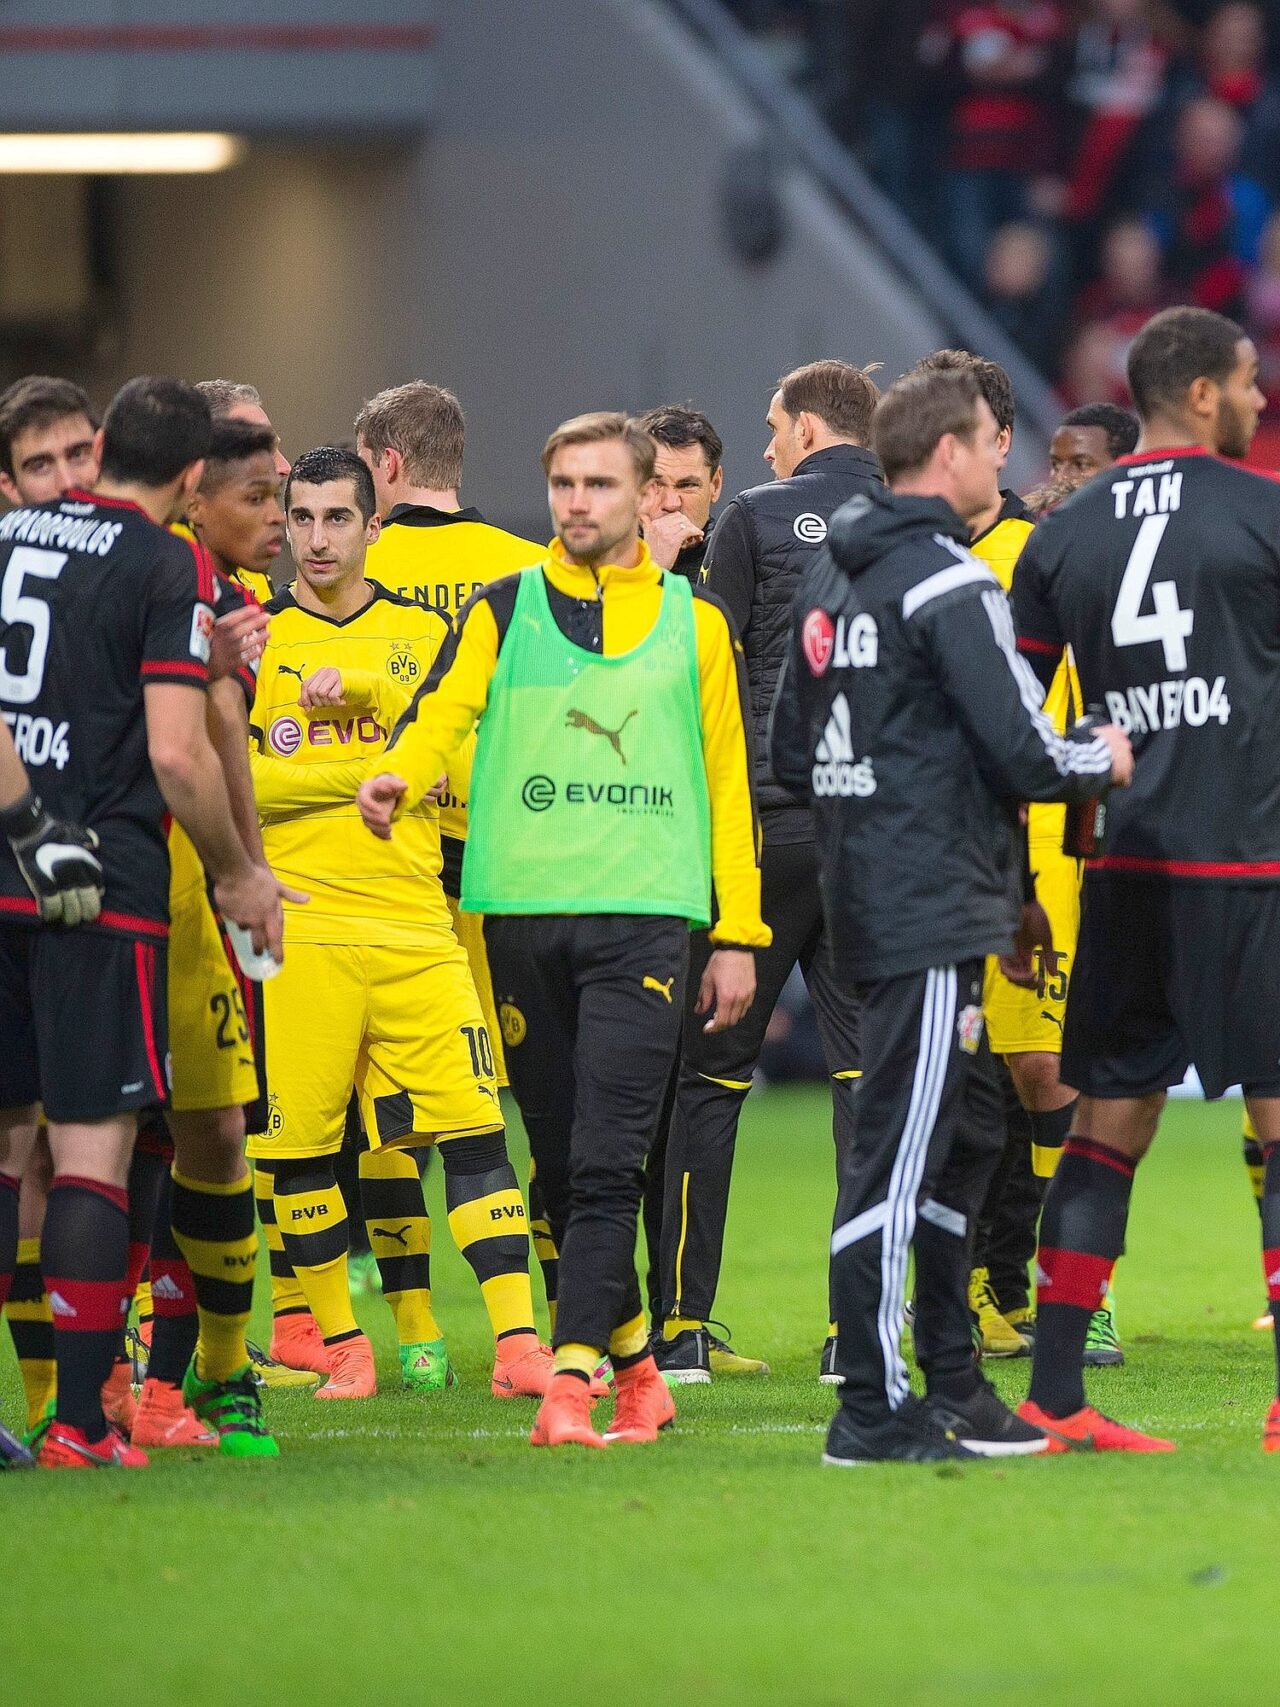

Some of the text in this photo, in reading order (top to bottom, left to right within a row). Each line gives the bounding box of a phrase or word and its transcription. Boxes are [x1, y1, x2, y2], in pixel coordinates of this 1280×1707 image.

[1111, 471, 1183, 519] TAH
[1111, 512, 1194, 673] 4
[0, 545, 69, 705] 5
[832, 612, 879, 668] LG
[390, 654, 418, 676] BVB
[399, 674, 410, 683] 09
[308, 716, 388, 746] EVO
[566, 783, 674, 807] EVONIK
[460, 1026, 494, 1078] 10
[290, 1204, 329, 1221] BVB
[489, 1205, 524, 1221] BVB
